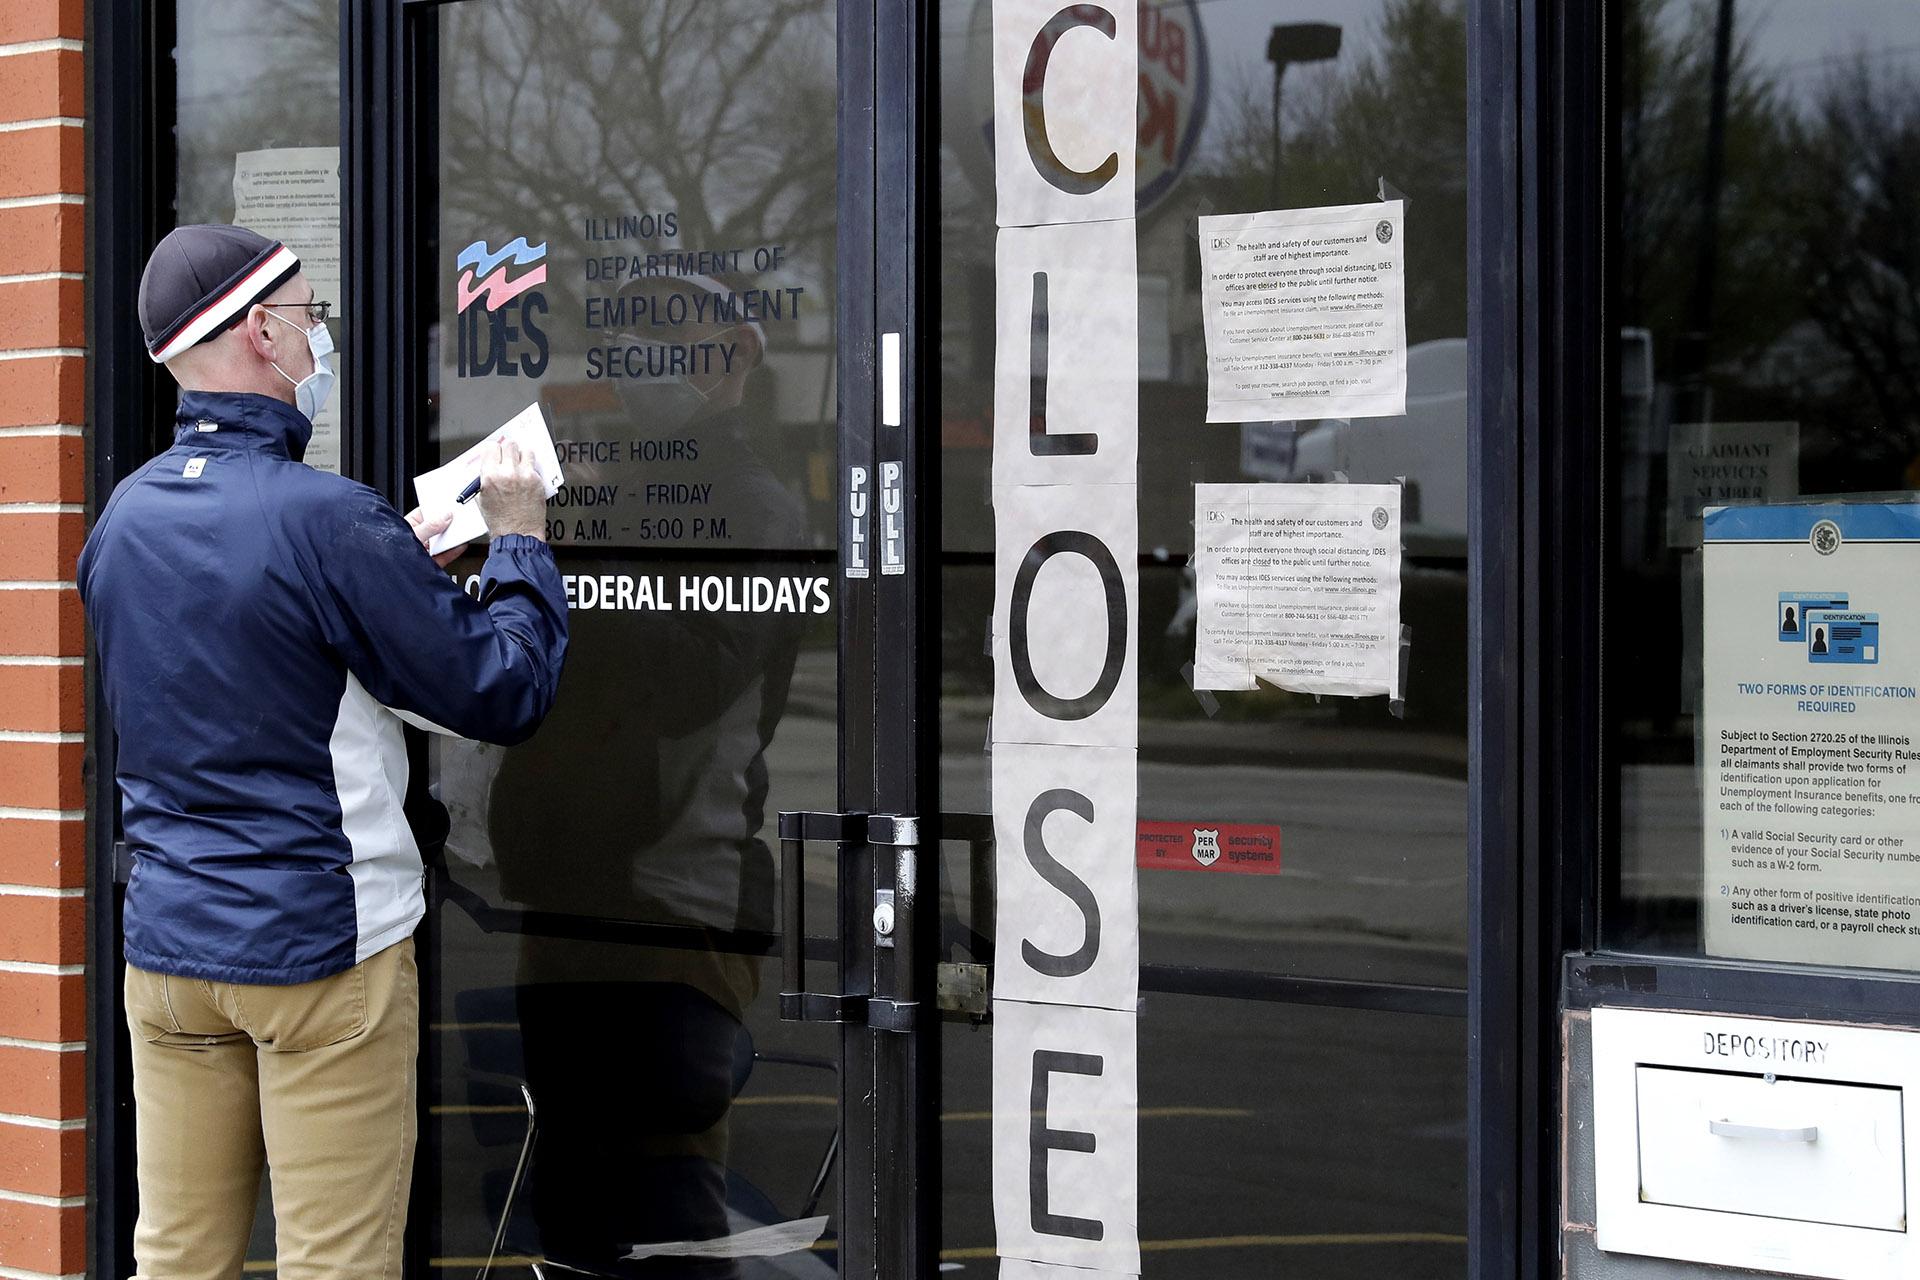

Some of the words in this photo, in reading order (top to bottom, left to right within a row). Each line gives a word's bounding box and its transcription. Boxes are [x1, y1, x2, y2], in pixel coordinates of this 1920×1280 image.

[585, 212, 678, 241] ILLINOIS
[1237, 243, 1247, 251] The
[1248, 241, 1267, 250] health
[1268, 240, 1281, 249] and
[1282, 239, 1301, 249] safety
[1303, 238, 1310, 247] of
[1324, 237, 1354, 245] customers
[1355, 234, 1367, 243] and
[585, 249, 739, 281] DEPARTMENT
[754, 247, 786, 271] OF
[1253, 253, 1267, 262] staff
[1280, 252, 1287, 260] of
[1288, 251, 1311, 261] highest
[1211, 272, 1217, 281] In
[1218, 272, 1236, 280] order
[1237, 271, 1243, 279] to
[1244, 270, 1267, 281] protect
[1268, 269, 1297, 278] everyone
[1299, 265, 1324, 276] through
[1325, 264, 1343, 273] social
[1378, 261, 1392, 270] IDES
[1225, 283, 1245, 292] offices
[1258, 280, 1278, 289] closed
[1279, 280, 1286, 288] to
[1287, 279, 1297, 288] the
[1298, 278, 1318, 289] public
[1319, 276, 1333, 285] until
[1334, 275, 1357, 284] further
[585, 288, 804, 329] EMPLOYMENT
[1221, 300, 1232, 308] You
[1233, 301, 1245, 309] may
[1263, 296, 1276, 305] IDES
[1277, 295, 1301, 304] services
[1303, 294, 1316, 304] using
[1317, 294, 1327, 302] the
[1328, 292, 1356, 302] following
[457, 291, 549, 379] IDES
[586, 343, 738, 379] SECURITY
[555, 441, 620, 464] OFFICE
[630, 439, 698, 462] HOURS
[646, 483, 712, 504] FRIDAY
[850, 467, 867, 567] PULL
[883, 463, 900, 565] PULL
[574, 519, 612, 541] A.M.
[640, 518, 683, 540] 5:00
[693, 517, 732, 540] P.M.
[562, 575, 672, 612] EDERAL
[680, 577, 830, 614] HOLIDAYS
[1738, 683, 1764, 695] TWO
[1767, 684, 1807, 695] FORMS
[1810, 685, 1825, 696] OF
[1828, 685, 1916, 698] IDENTIFICATION
[1798, 701, 1856, 712] REQUIRED
[1720, 730, 1757, 743] Subject
[1759, 732, 1769, 741] to
[1771, 731, 1808, 742] Section
[1810, 732, 1846, 743] 2720.25
[1848, 733, 1858, 744] of
[1860, 734, 1876, 744] the
[1878, 734, 1910, 745] Illinois
[1720, 744, 1776, 757] Department
[1779, 746, 1789, 756] of
[1791, 746, 1851, 760] Employment
[1853, 748, 1892, 762] Security
[1720, 758, 1732, 768] all
[1734, 758, 1780, 770] claimants
[1783, 760, 1806, 771] shall
[1808, 761, 1844, 774] provide
[1847, 763, 1864, 773] two
[1866, 763, 1894, 774] forms
[1896, 764, 1906, 774] of
[1720, 772, 1782, 784] identification
[1785, 776, 1809, 788] upon
[1812, 776, 1865, 789] application
[1868, 777, 1881, 788] for
[1720, 786, 1792, 801] Unemployment
[1794, 789, 1842, 801] Insurance
[1845, 791, 1886, 804] benefits,
[1888, 795, 1906, 803] one
[1909, 793, 1920, 804] fro
[1720, 801, 1742, 811] each
[1745, 801, 1754, 812] of
[1757, 802, 1772, 812] the
[1774, 802, 1818, 817] following
[1821, 805, 1875, 818] categories:
[1139, 834, 1184, 843] PROTECTED
[1198, 836, 1214, 847] PER
[1228, 835, 1273, 849] security
[1720, 828, 1729, 841] 1)
[1731, 829, 1739, 839] A
[1741, 829, 1763, 840] valid
[1766, 830, 1795, 842] Social
[1797, 832, 1837, 846] Security
[1840, 834, 1862, 845] card
[1864, 837, 1875, 845] or
[1877, 836, 1904, 847] other
[1155, 849, 1167, 857] BY
[1197, 849, 1215, 859] MAR
[1228, 850, 1274, 863] systems
[1731, 843, 1773, 855] evidence
[1775, 845, 1785, 855] of
[1787, 848, 1808, 859] your
[1810, 847, 1841, 858] Social
[1843, 848, 1885, 863] Security
[1887, 851, 1920, 862] numbe
[1731, 858, 1754, 869] such
[1757, 861, 1768, 869] as
[1770, 861, 1776, 870] a
[1777, 860, 1795, 871] W-2
[1797, 861, 1822, 872] form.
[1720, 884, 1730, 898] 2)
[1732, 885, 1751, 899] Any
[1753, 887, 1777, 898] other
[1780, 888, 1801, 899] form
[1803, 889, 1813, 900] of
[1816, 890, 1853, 903] positive
[1731, 900, 1755, 911] such
[1757, 903, 1768, 911] as
[1770, 904, 1776, 912] a
[1778, 902, 1813, 914] driver's
[1815, 904, 1852, 918] license,
[1854, 908, 1879, 918] state
[1881, 909, 1911, 921] photo
[1731, 913, 1793, 927] identification
[1795, 918, 1818, 931] card,
[1820, 921, 1830, 930] or
[1832, 922, 1838, 930] a
[1840, 922, 1874, 934] payroll
[1877, 923, 1906, 935] check
[1704, 1032, 1830, 1064] DEPOSITORY
